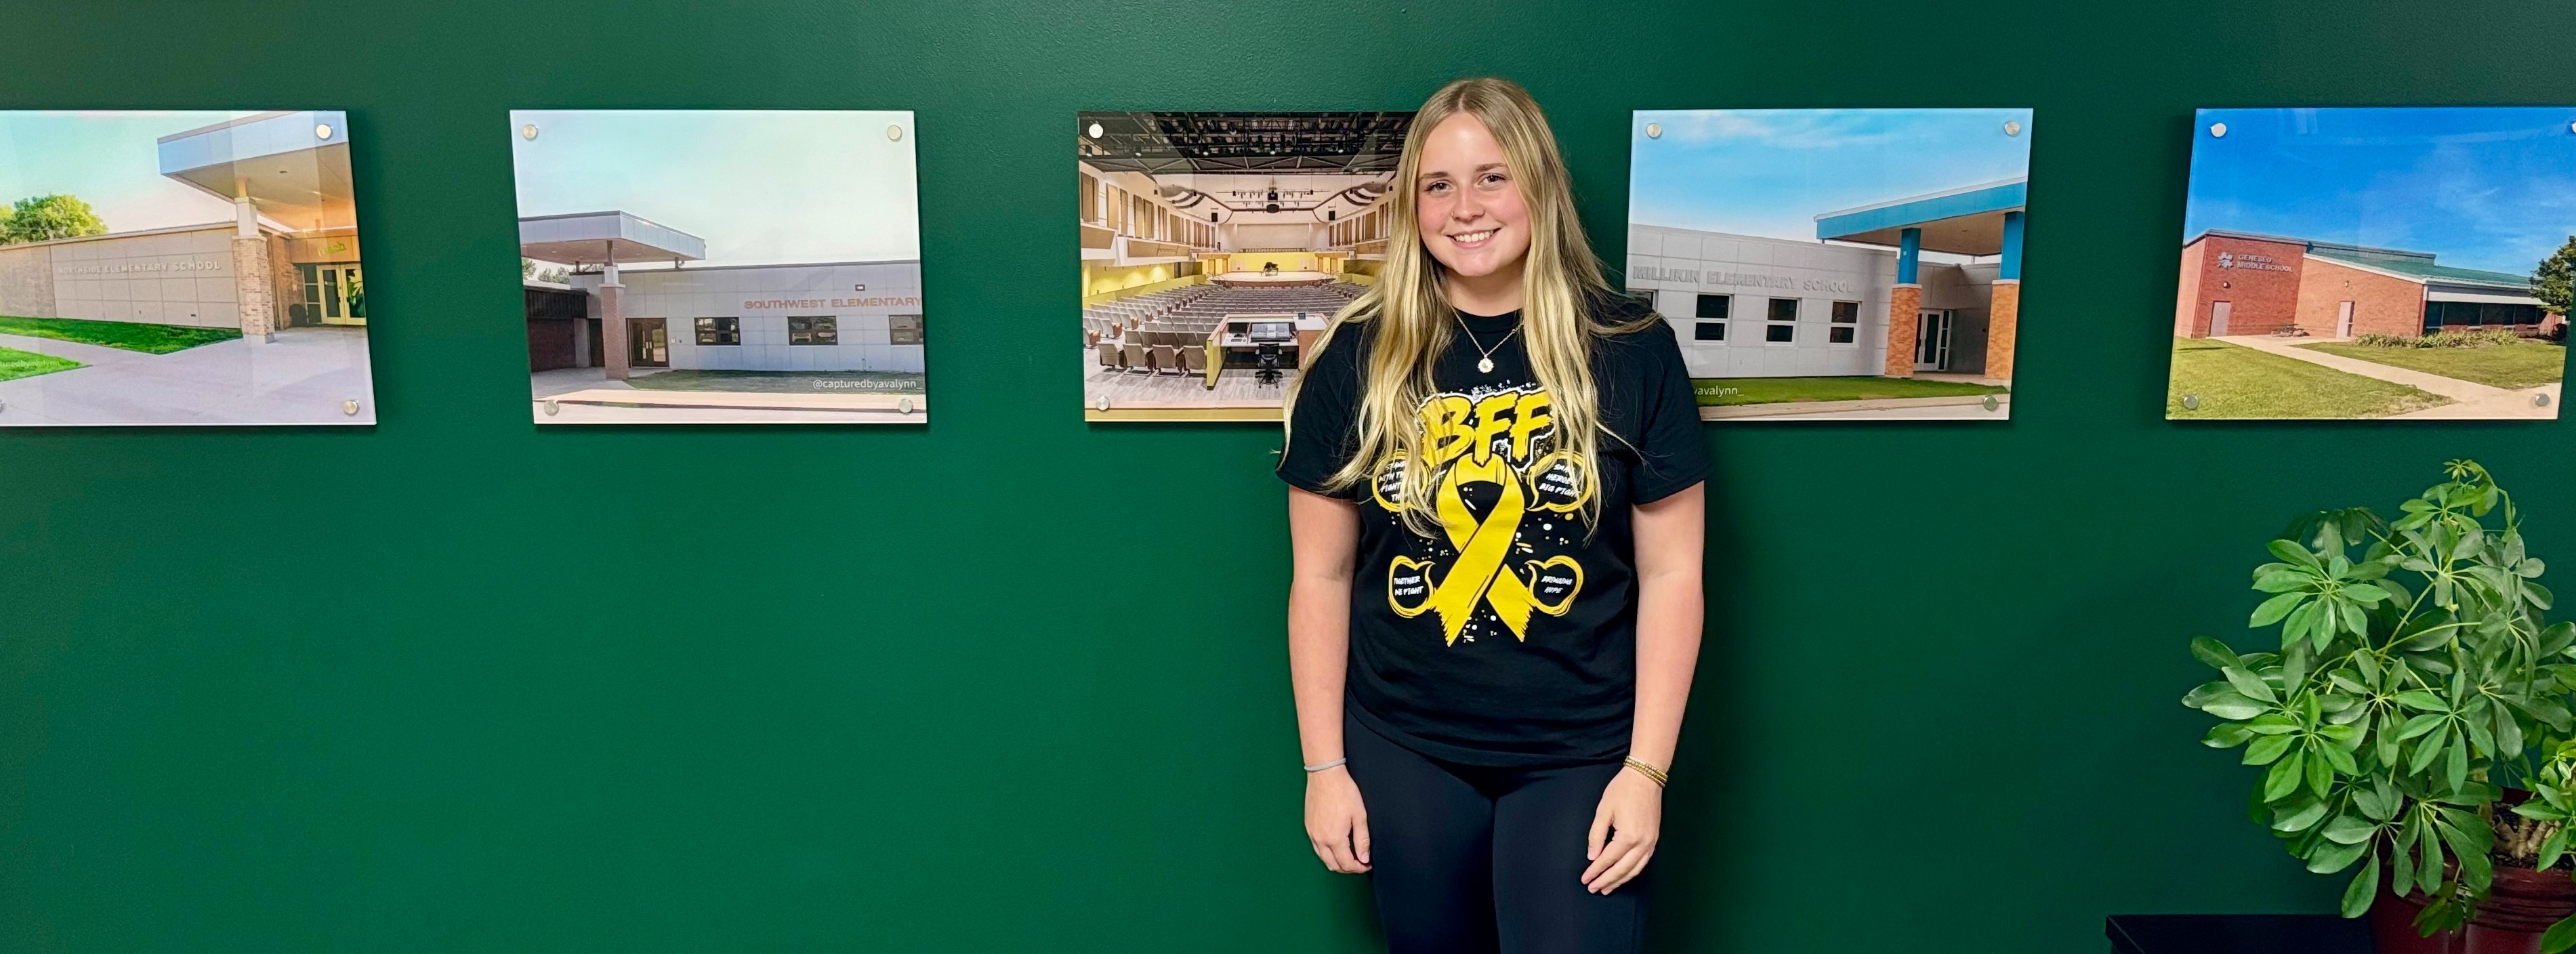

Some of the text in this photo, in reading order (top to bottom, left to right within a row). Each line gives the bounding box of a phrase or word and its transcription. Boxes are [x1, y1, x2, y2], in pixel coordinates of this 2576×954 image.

[104, 262, 169, 274] ELEMENTARY
[173, 260, 221, 271] SCHOOL
[2237, 262, 2293, 272] MIDDLE SCHOOL
[1633, 266, 1854, 293] MILLIKIN ELEMENTARY SCHOOL
[744, 297, 922, 310] SOUTHWEST ELEMENTARY
[813, 378, 923, 390] @capturedbyavalynn_
[1419, 390, 1553, 472] BFF
[1538, 482, 1556, 493] BIG
[1394, 575, 1421, 585] TOGETHER
[1541, 575, 1573, 585] BRINGING
[1394, 585, 1424, 596] WE FIGHT
